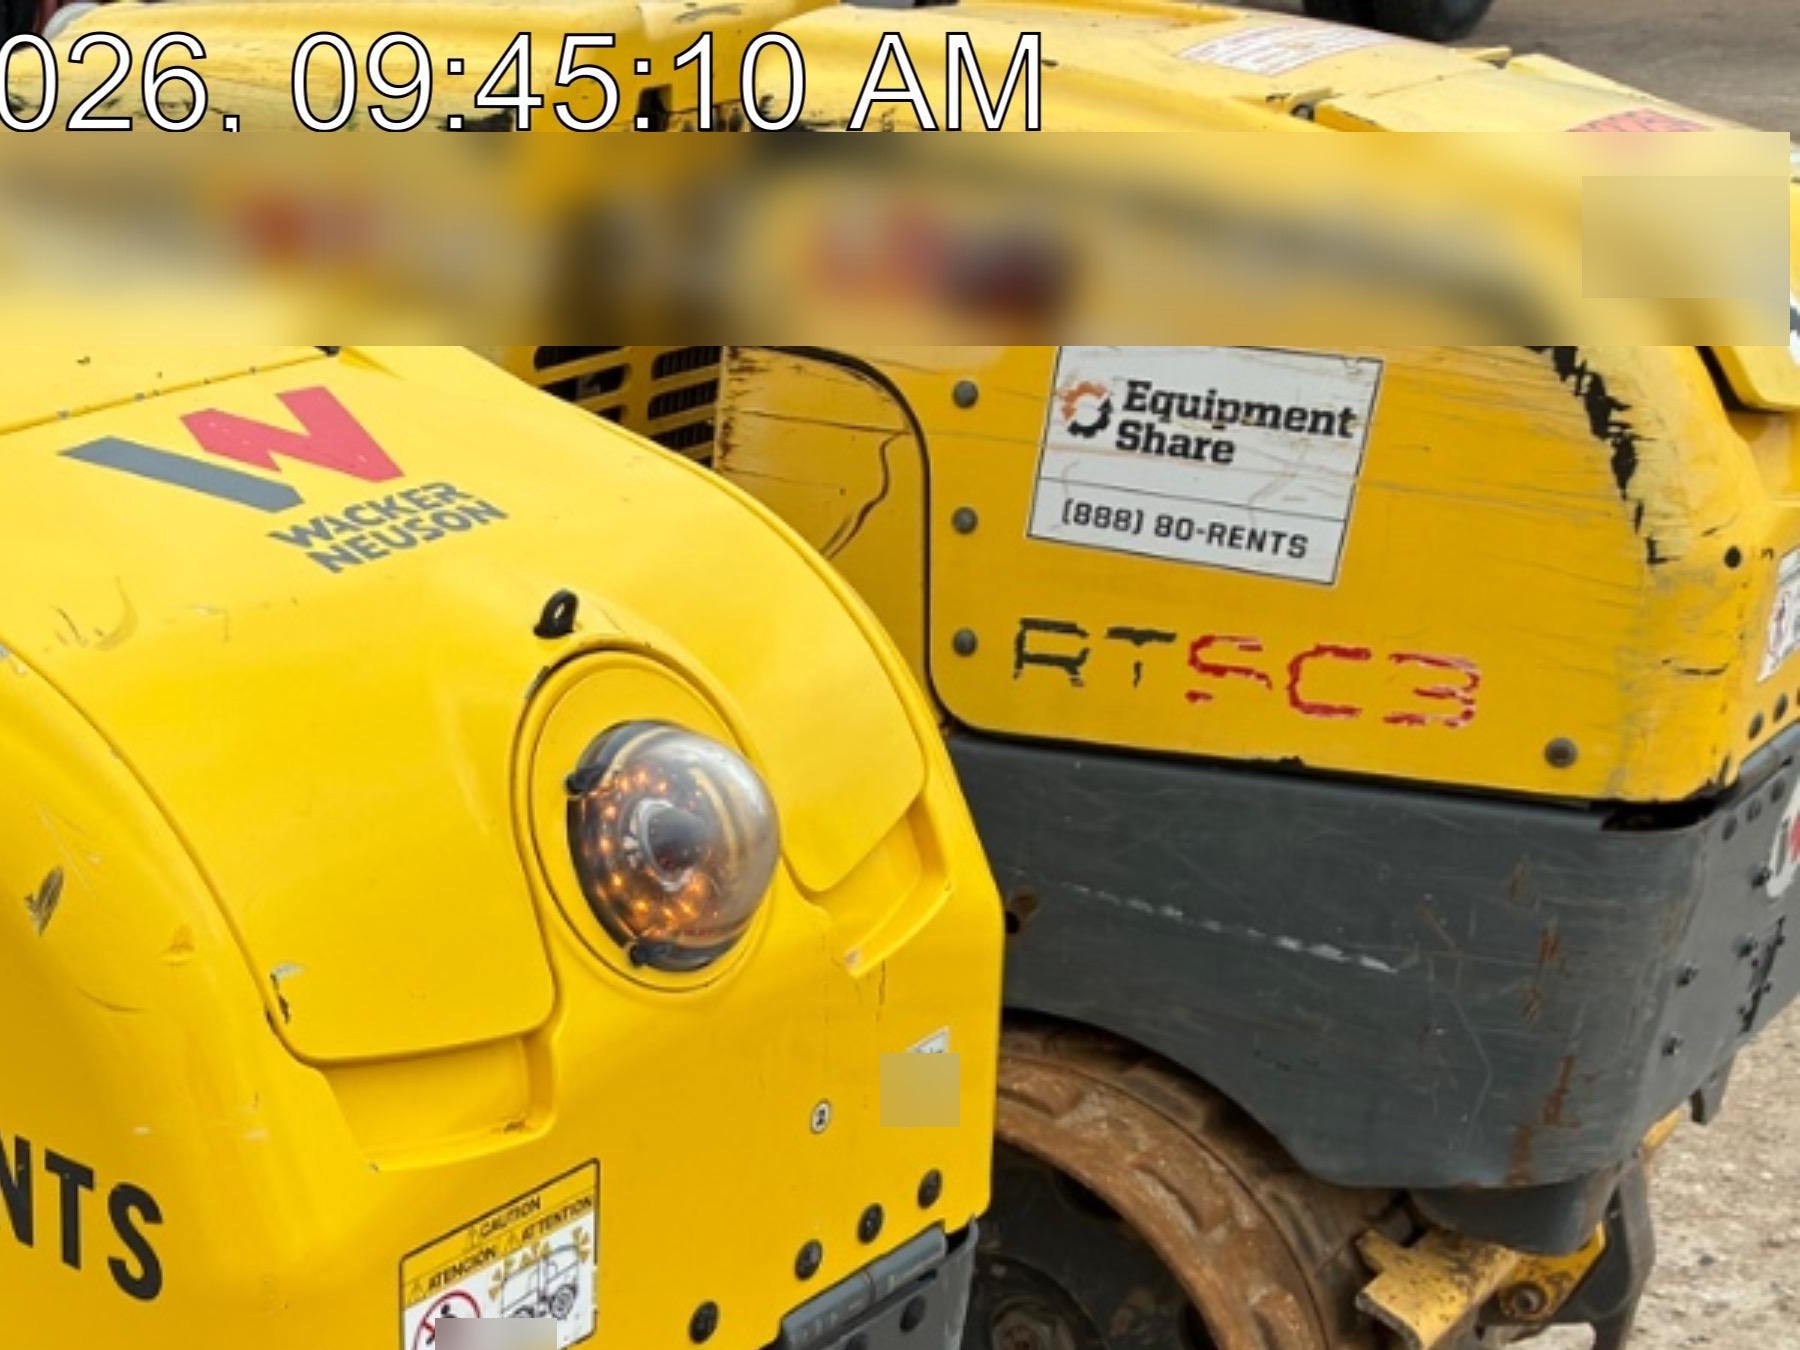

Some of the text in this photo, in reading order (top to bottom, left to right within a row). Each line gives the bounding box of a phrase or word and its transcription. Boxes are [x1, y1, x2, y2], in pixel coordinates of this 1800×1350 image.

[1122, 378, 1359, 441] Equipment
[1114, 418, 1236, 466] Share
[266, 481, 475, 549] WACKER
[306, 499, 509, 574] NEUSON
[1153, 512, 1309, 560] 80-RENTS
[479, 1196, 542, 1238] CAUTION
[521, 1195, 593, 1242] ATTENTION
